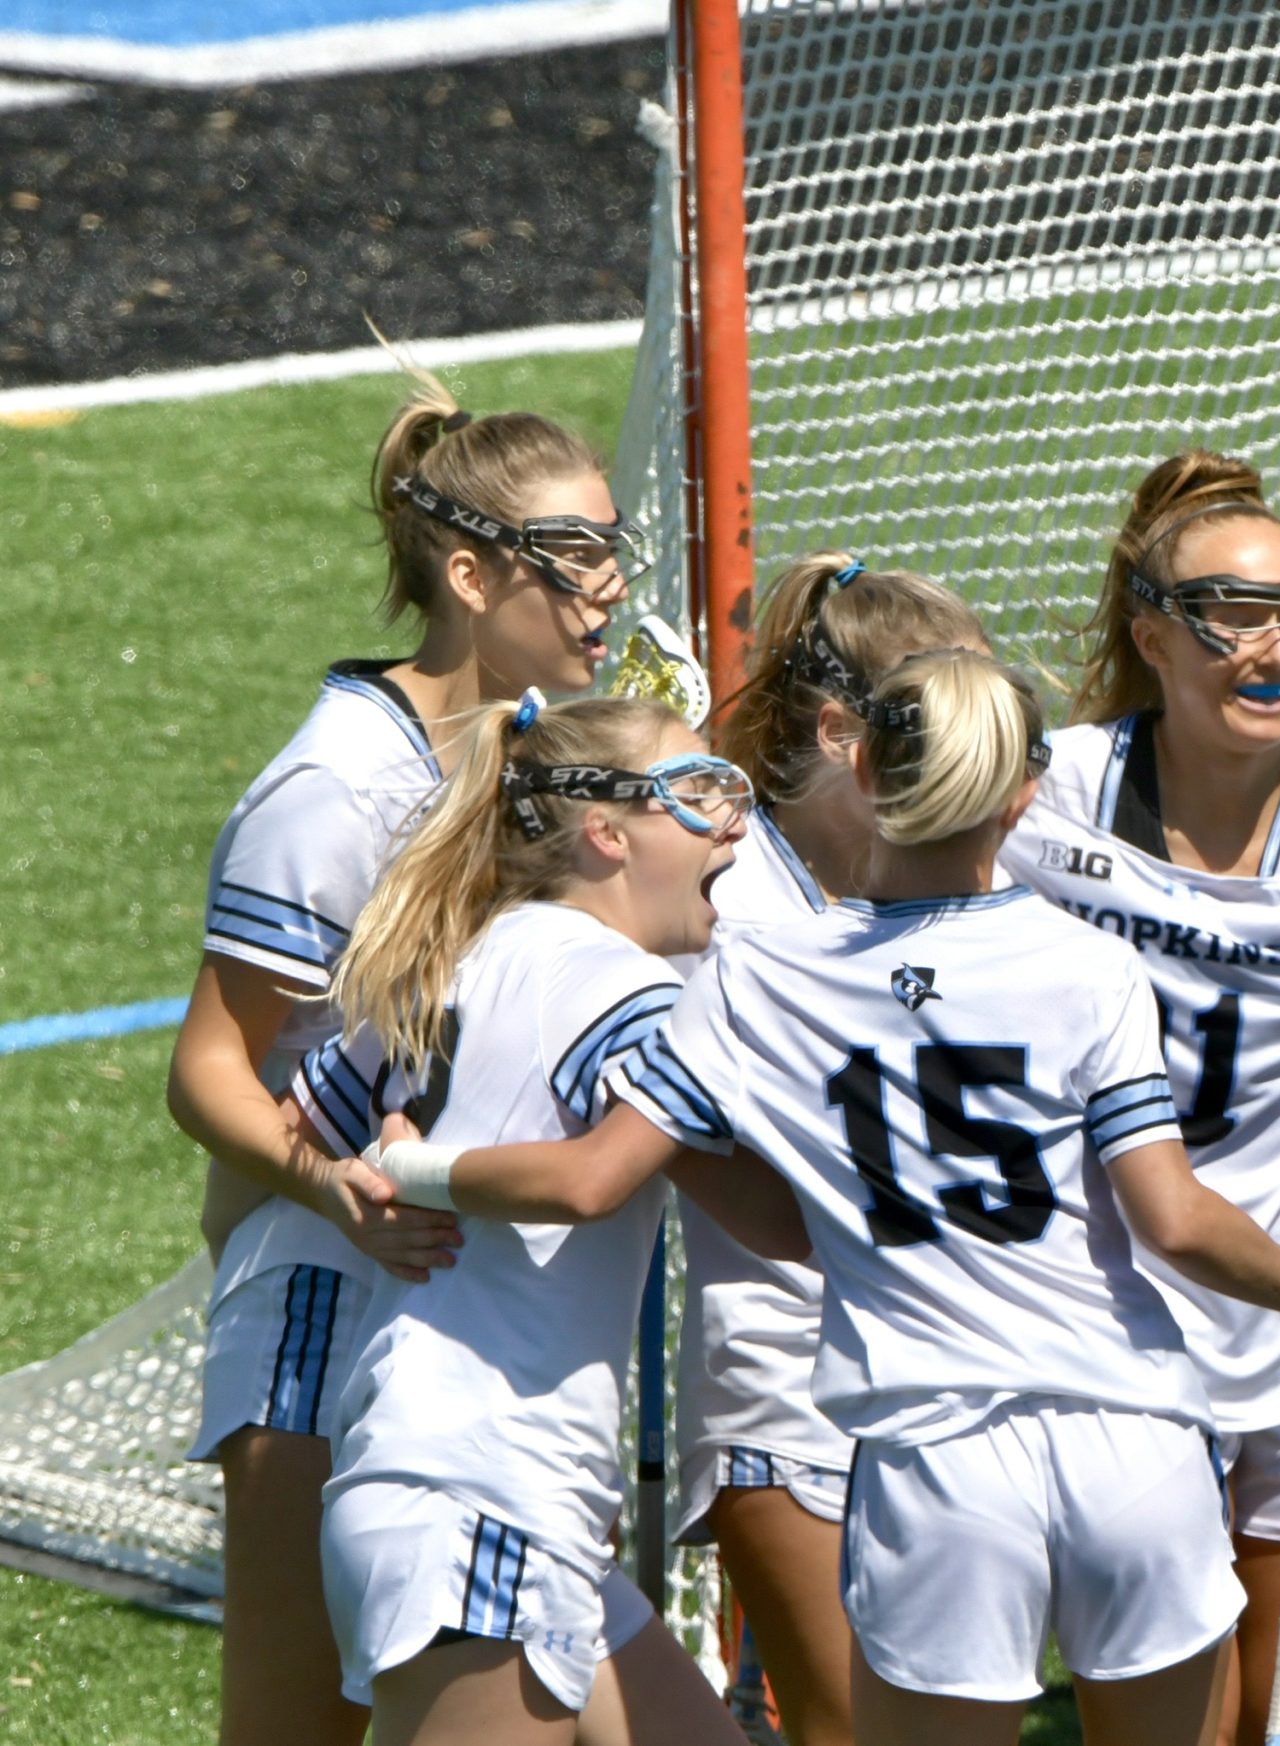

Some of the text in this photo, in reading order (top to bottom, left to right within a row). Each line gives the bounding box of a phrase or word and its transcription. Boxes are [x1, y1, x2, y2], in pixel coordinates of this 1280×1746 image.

[449, 504, 502, 540] STX
[887, 702, 922, 726] ST
[550, 766, 614, 785] STX
[613, 779, 656, 799] ST
[1150, 978, 1244, 1148] 1
[823, 1041, 1059, 1249] 15
